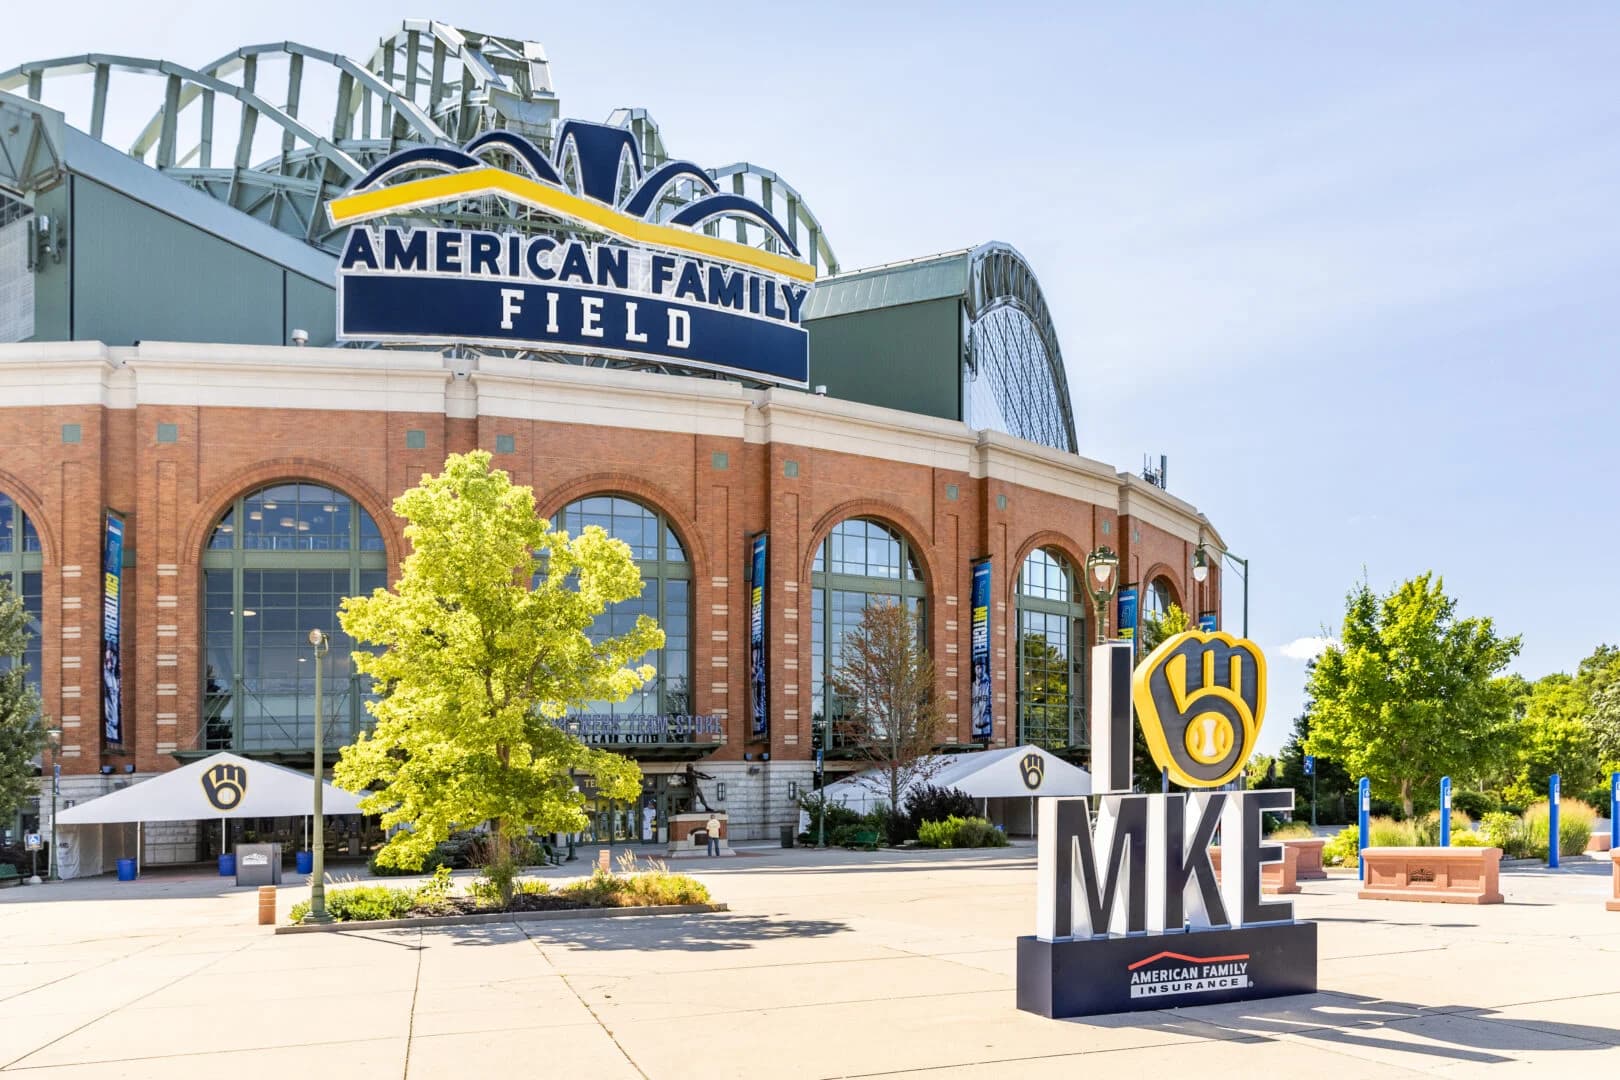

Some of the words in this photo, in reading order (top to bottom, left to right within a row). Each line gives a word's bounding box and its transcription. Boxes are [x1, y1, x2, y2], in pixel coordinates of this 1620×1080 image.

[341, 227, 630, 289] AMERICAN
[651, 255, 809, 324] FAMILY
[500, 288, 691, 348] FIELD
[104, 572, 120, 644] CONTRERAS
[752, 586, 762, 643] HOSKINS
[973, 606, 989, 661] MITCHELL
[627, 714, 668, 735] TEAM
[676, 714, 721, 735] STORE
[1048, 788, 1295, 941] MKE
[1130, 967, 1198, 984] AMERICAN
[1203, 962, 1248, 977] FAMILY
[1140, 978, 1240, 995] INSURANCE
